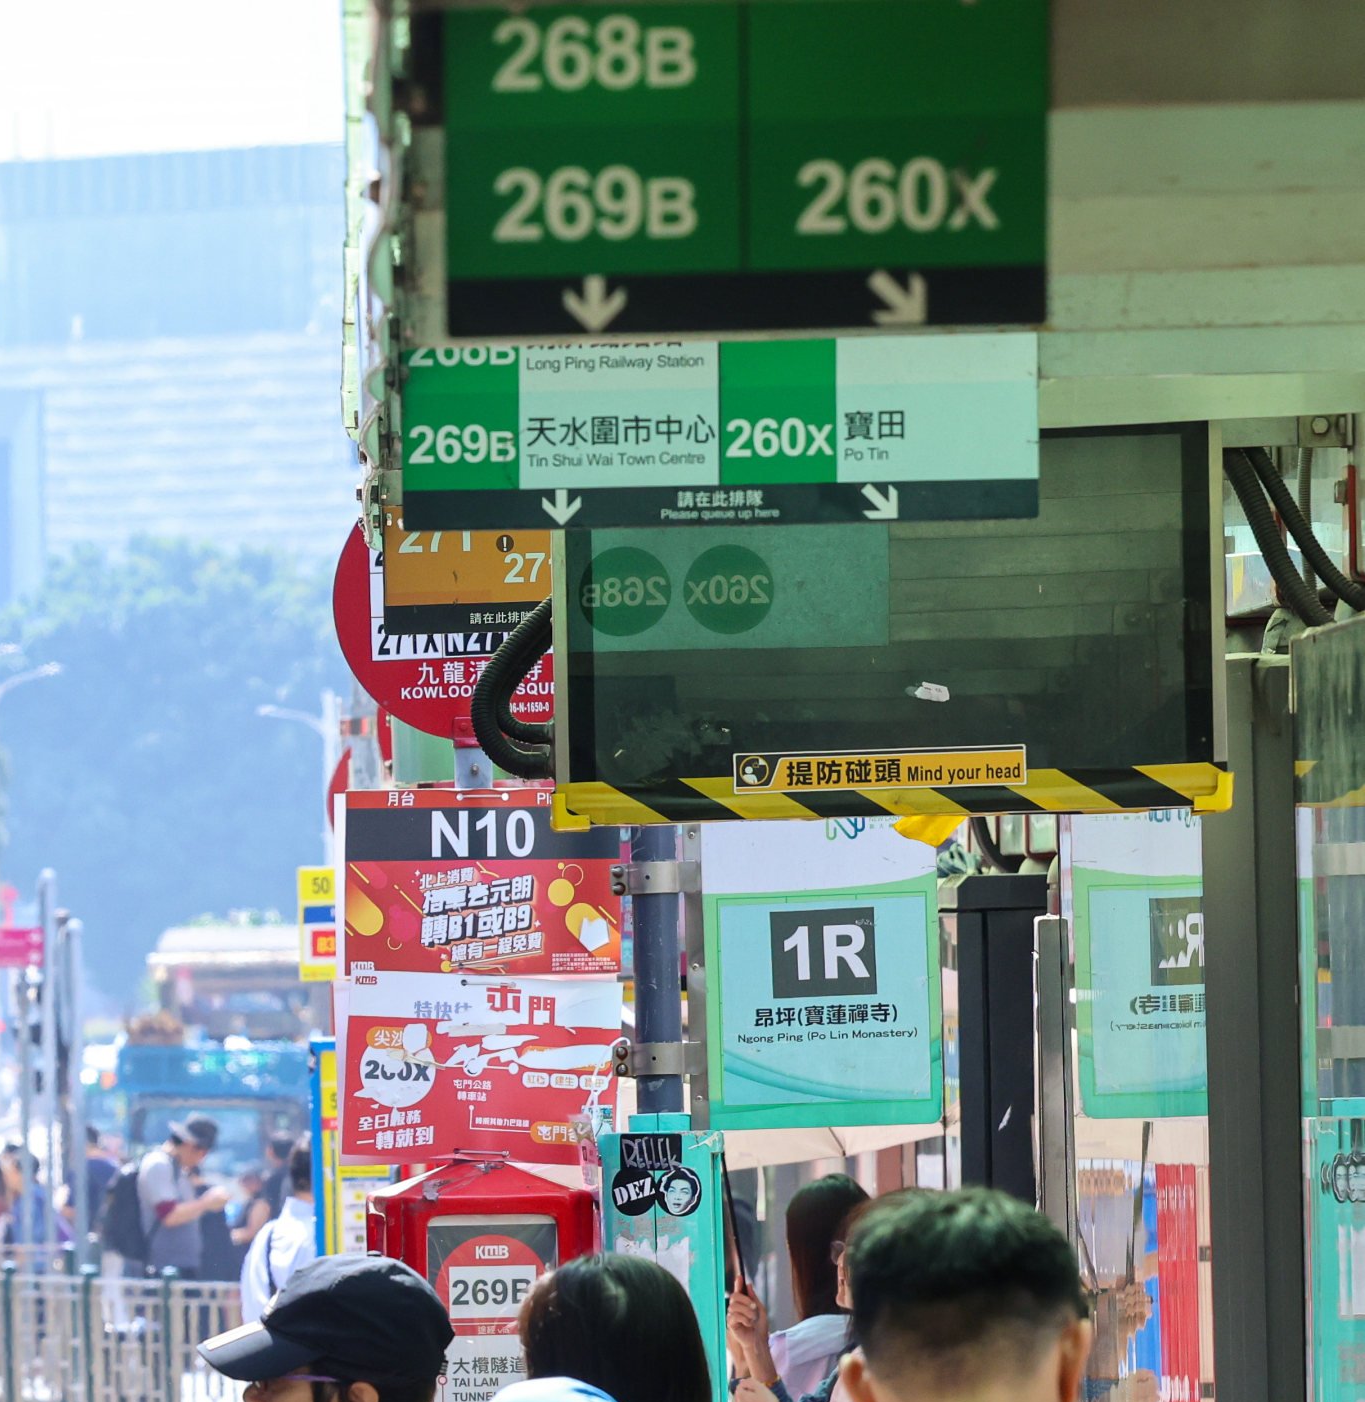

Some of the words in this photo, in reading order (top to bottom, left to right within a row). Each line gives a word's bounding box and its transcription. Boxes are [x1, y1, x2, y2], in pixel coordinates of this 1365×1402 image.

[491, 13, 696, 93] 268B
[492, 165, 698, 243] 269B
[796, 156, 1000, 235] 260X
[526, 356, 560, 373] Long
[565, 356, 596, 373] Ping
[599, 355, 653, 372] Railway
[657, 353, 704, 369] Station
[526, 414, 716, 447] 天水圍市中心
[725, 417, 834, 459] 260X
[844, 410, 905, 441] 寶田
[408, 424, 517, 464] 269B
[844, 447, 864, 461] Po
[867, 446, 890, 461] Tin
[526, 453, 545, 468] Tin
[549, 453, 583, 468] Shui
[587, 453, 613, 467] Wai
[617, 452, 656, 467] Town
[659, 451, 706, 466] Centre
[677, 490, 764, 508] 請在此排隊
[661, 508, 698, 520] Please
[700, 508, 736, 521] queue
[738, 508, 753, 521] up
[754, 506, 780, 519] here
[503, 552, 552, 584] 27
[417, 660, 543, 686] 九龍清寺
[401, 684, 475, 700] KOWLOO
[786, 758, 901, 786] 提防碰頭
[907, 765, 943, 782] Mind
[948, 766, 981, 785] your
[985, 763, 1021, 779] head
[387, 791, 415, 807] 月台
[431, 809, 535, 858] N10
[419, 866, 474, 889] 北上消費
[451, 932, 543, 963] 總有一程免費
[783, 924, 870, 981] 1R
[350, 961, 375, 971] KMB
[355, 976, 378, 985] KMB
[754, 1003, 898, 1028] 昂坪(寶蓮禪寺)
[374, 1029, 404, 1047] 尖沙
[738, 1034, 774, 1044] Ngong
[777, 1032, 804, 1043] Ping
[807, 1031, 826, 1042] (Po
[829, 1030, 849, 1040] Lin
[852, 1027, 918, 1039] Monastery)
[356, 1126, 433, 1151] 一轉就到
[613, 1177, 656, 1206] DEZ
[475, 1245, 509, 1259] KMB
[453, 1377, 471, 1387] TAI
[474, 1377, 499, 1387] LAM
[452, 1392, 496, 1402] TUNNE
